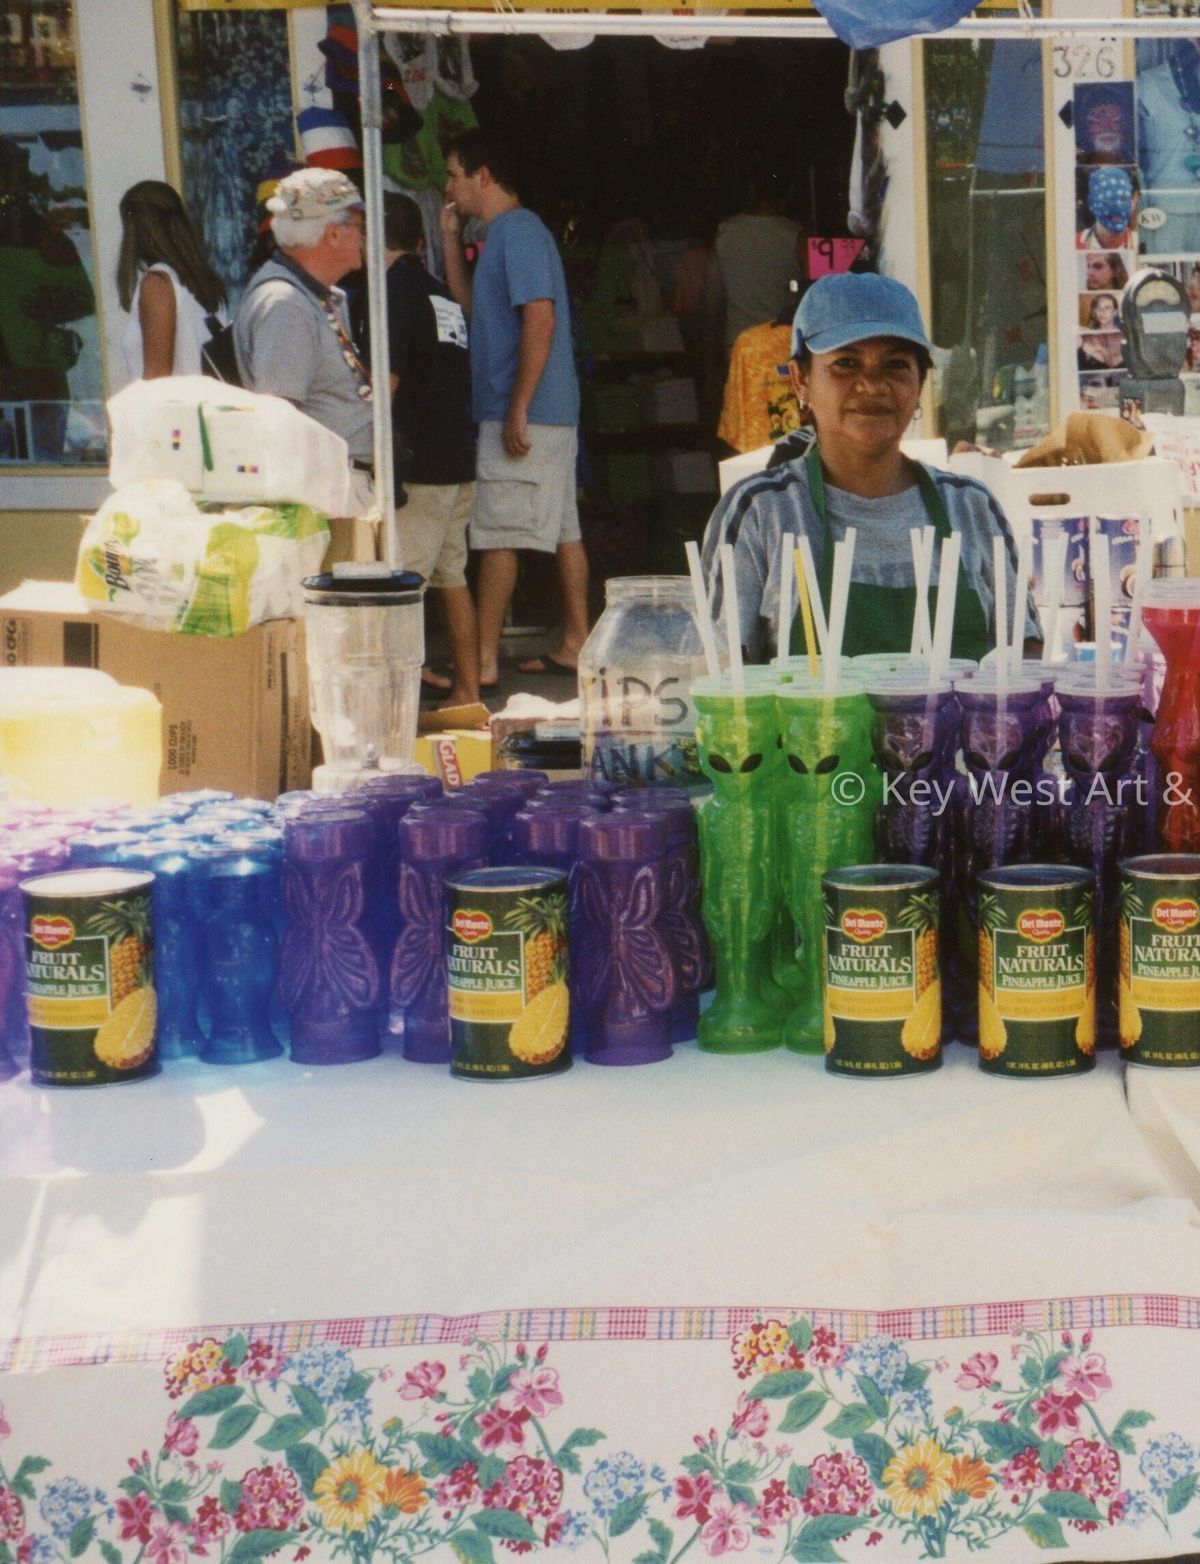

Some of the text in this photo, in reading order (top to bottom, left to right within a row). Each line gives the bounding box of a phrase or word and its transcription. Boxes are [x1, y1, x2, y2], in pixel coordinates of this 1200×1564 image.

[1053, 47, 1114, 78] 326
[440, 740, 461, 786] GLAD
[1156, 908, 1196, 918] Del Monte
[844, 917, 884, 928] Del Monte
[1022, 918, 1062, 928] Del Monte
[32, 951, 82, 966] FRUIT
[452, 944, 498, 960] FRUIT
[841, 944, 892, 958] FRUIT
[1016, 944, 1069, 958] FRUIT
[829, 954, 912, 974] NATURALS
[998, 954, 1084, 974] NATURALS
[1138, 964, 1190, 977] PINEAPPLE
[486, 976, 516, 991] JUICE
[831, 973, 908, 990] PINEAPPLE JUICE
[1002, 973, 1080, 988] PINEAPPLE JUICE
